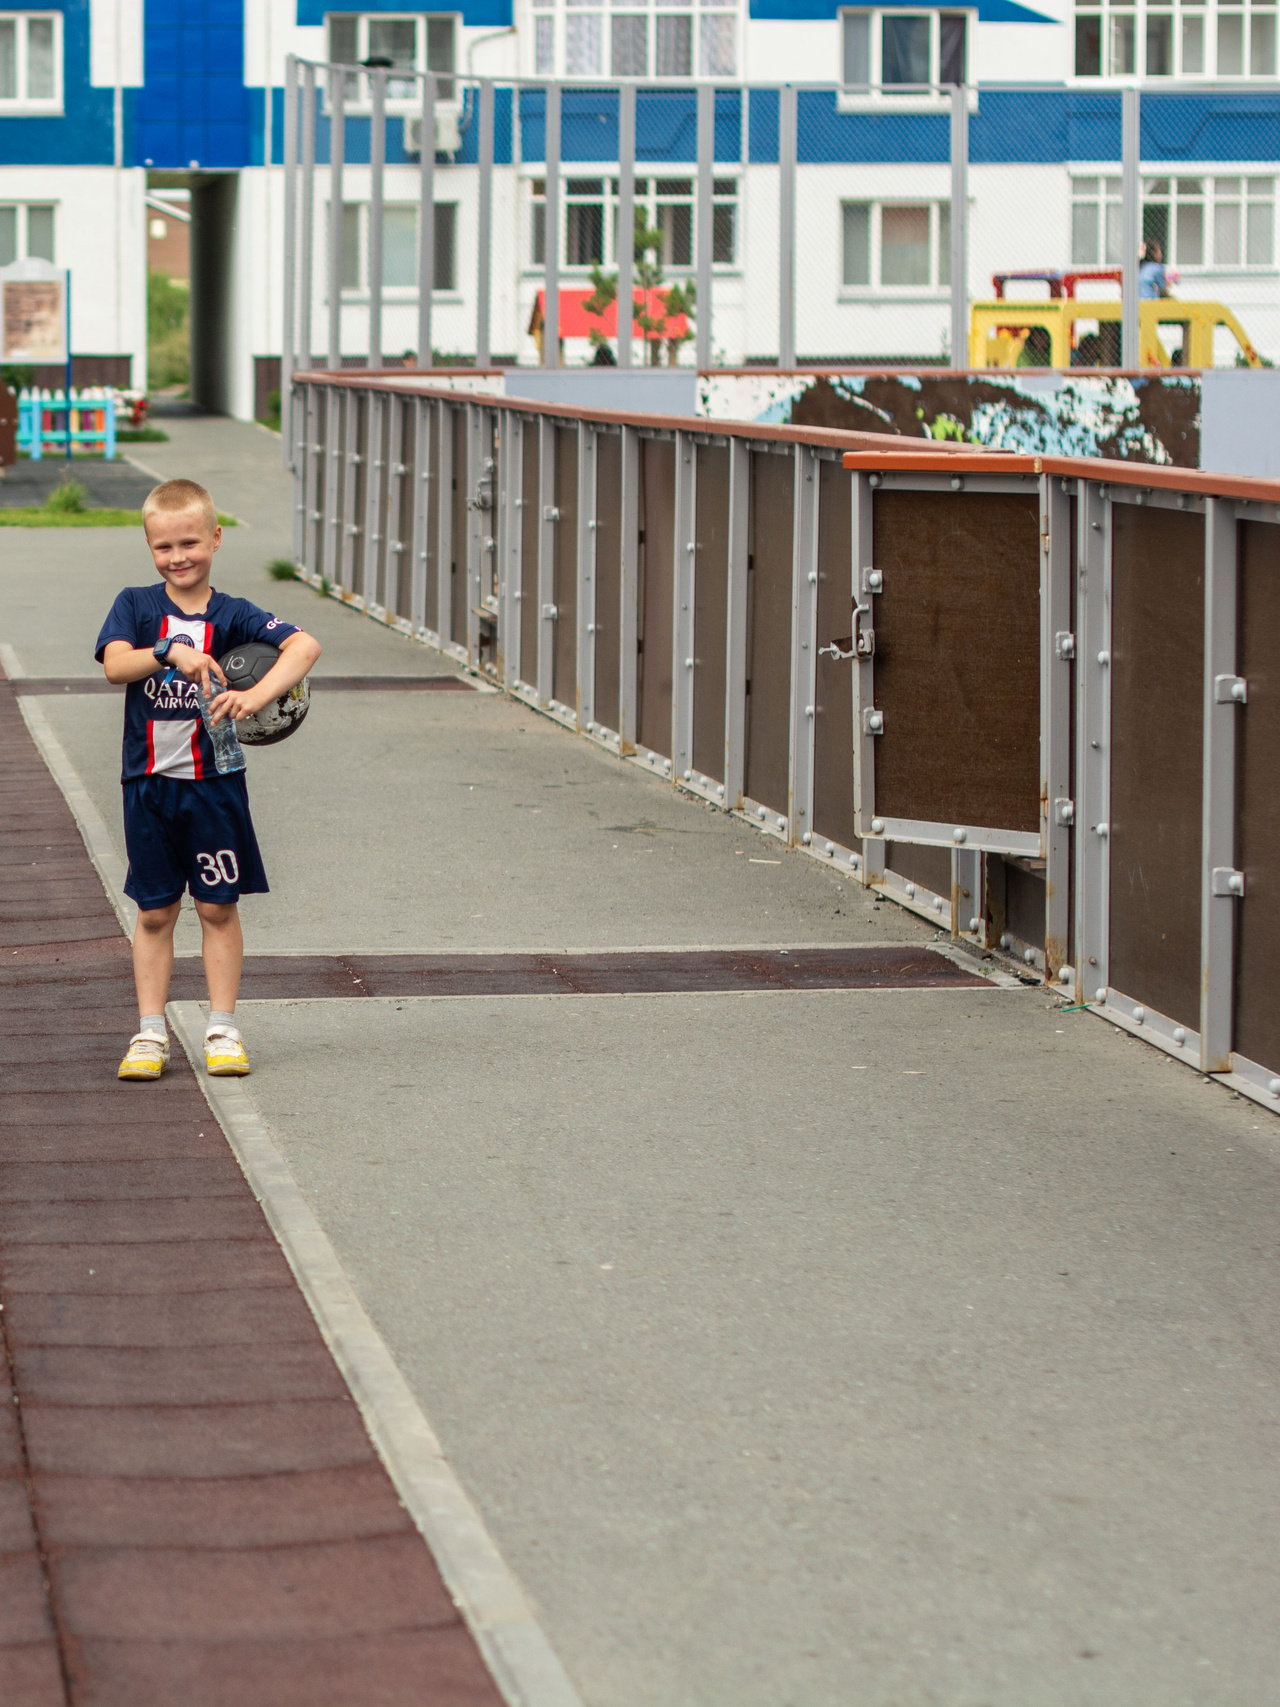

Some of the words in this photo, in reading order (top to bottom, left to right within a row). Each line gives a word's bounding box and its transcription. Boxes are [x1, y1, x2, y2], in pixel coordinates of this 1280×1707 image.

[144, 677, 199, 700] QATA
[153, 697, 200, 709] AIRWA
[196, 849, 239, 886] 30
